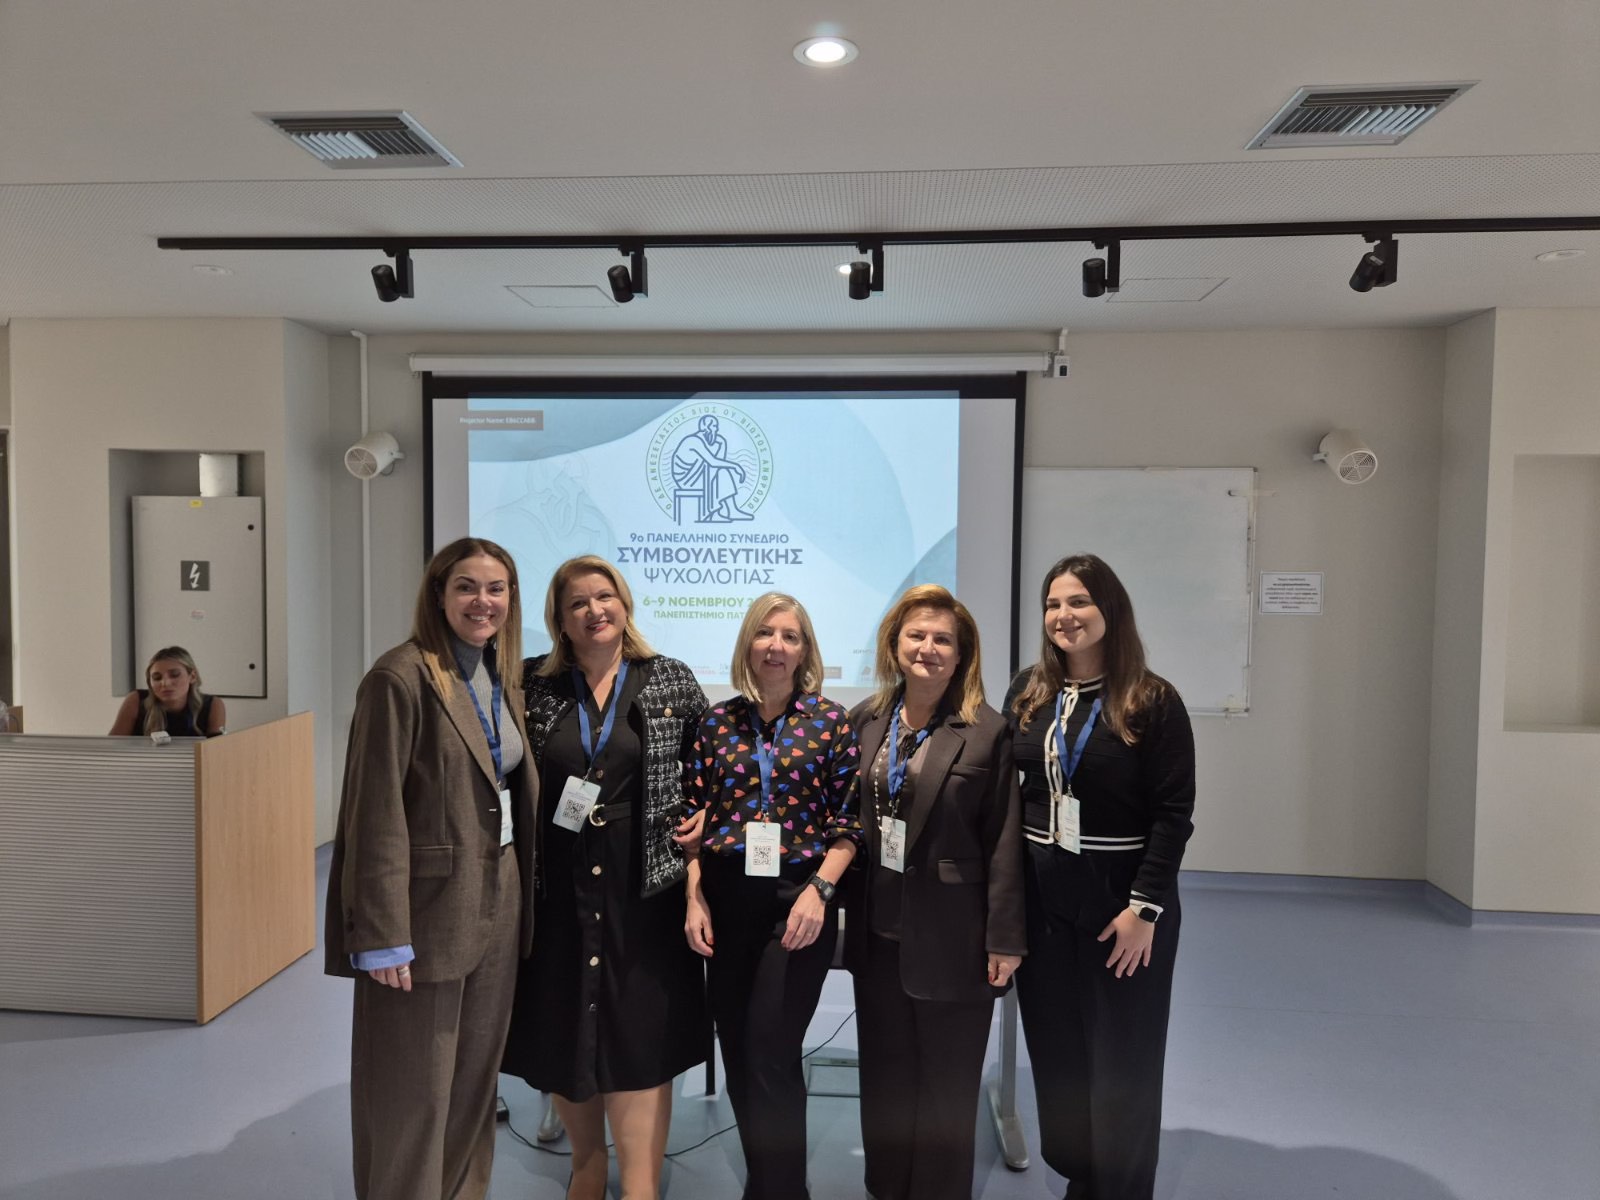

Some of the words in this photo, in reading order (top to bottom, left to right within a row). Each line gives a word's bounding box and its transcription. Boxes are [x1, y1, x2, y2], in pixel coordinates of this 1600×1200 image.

[647, 533, 727, 543] ΠΑΝΕΛΛΗΝΙΟ
[729, 533, 789, 544] ΣΥΝΕΔΡΙΟ
[617, 547, 803, 564] ΣΥΜΒΟΥΛΕΥΤΙΚΗΣ
[644, 567, 775, 585] ΨΥΧΟΛΟΓΙΑΣ
[668, 596, 744, 608] ΝΟΕΜΒΡΙΟΥ
[654, 610, 725, 619] ΠΑΝΕΠΙΣΤΗΜΙΟ
[727, 611, 745, 619] ΠΑΤ
